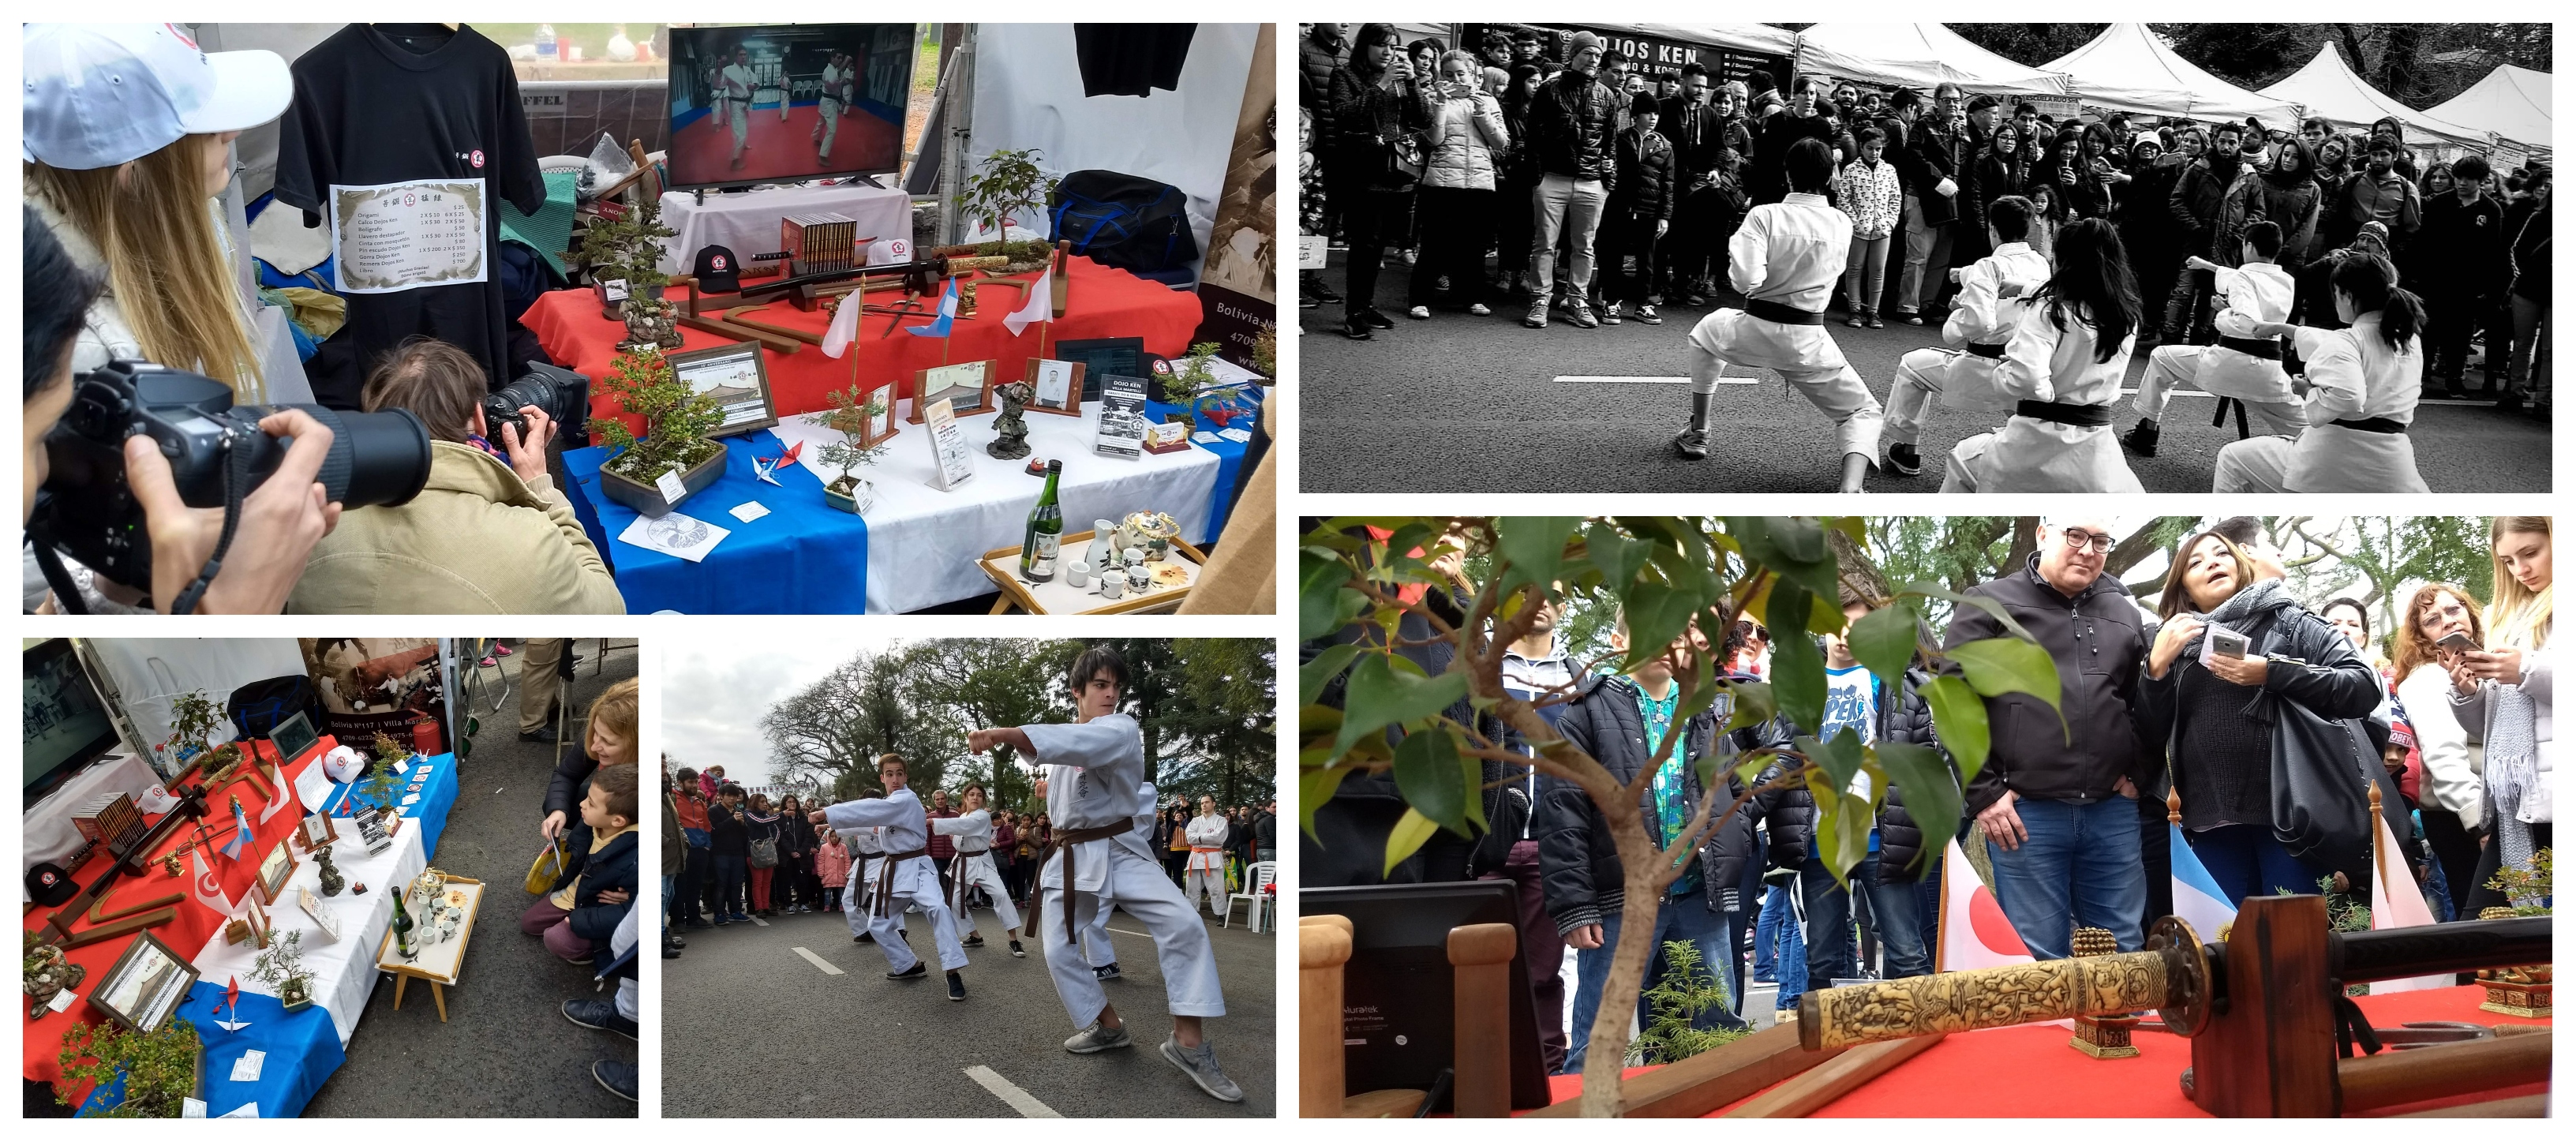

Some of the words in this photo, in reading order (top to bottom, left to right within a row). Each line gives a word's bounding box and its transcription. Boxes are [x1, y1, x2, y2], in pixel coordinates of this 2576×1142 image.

[1658, 44, 1697, 65] KEN
[1642, 64, 1650, 73] &
[1216, 302, 1259, 326] Bolivia
